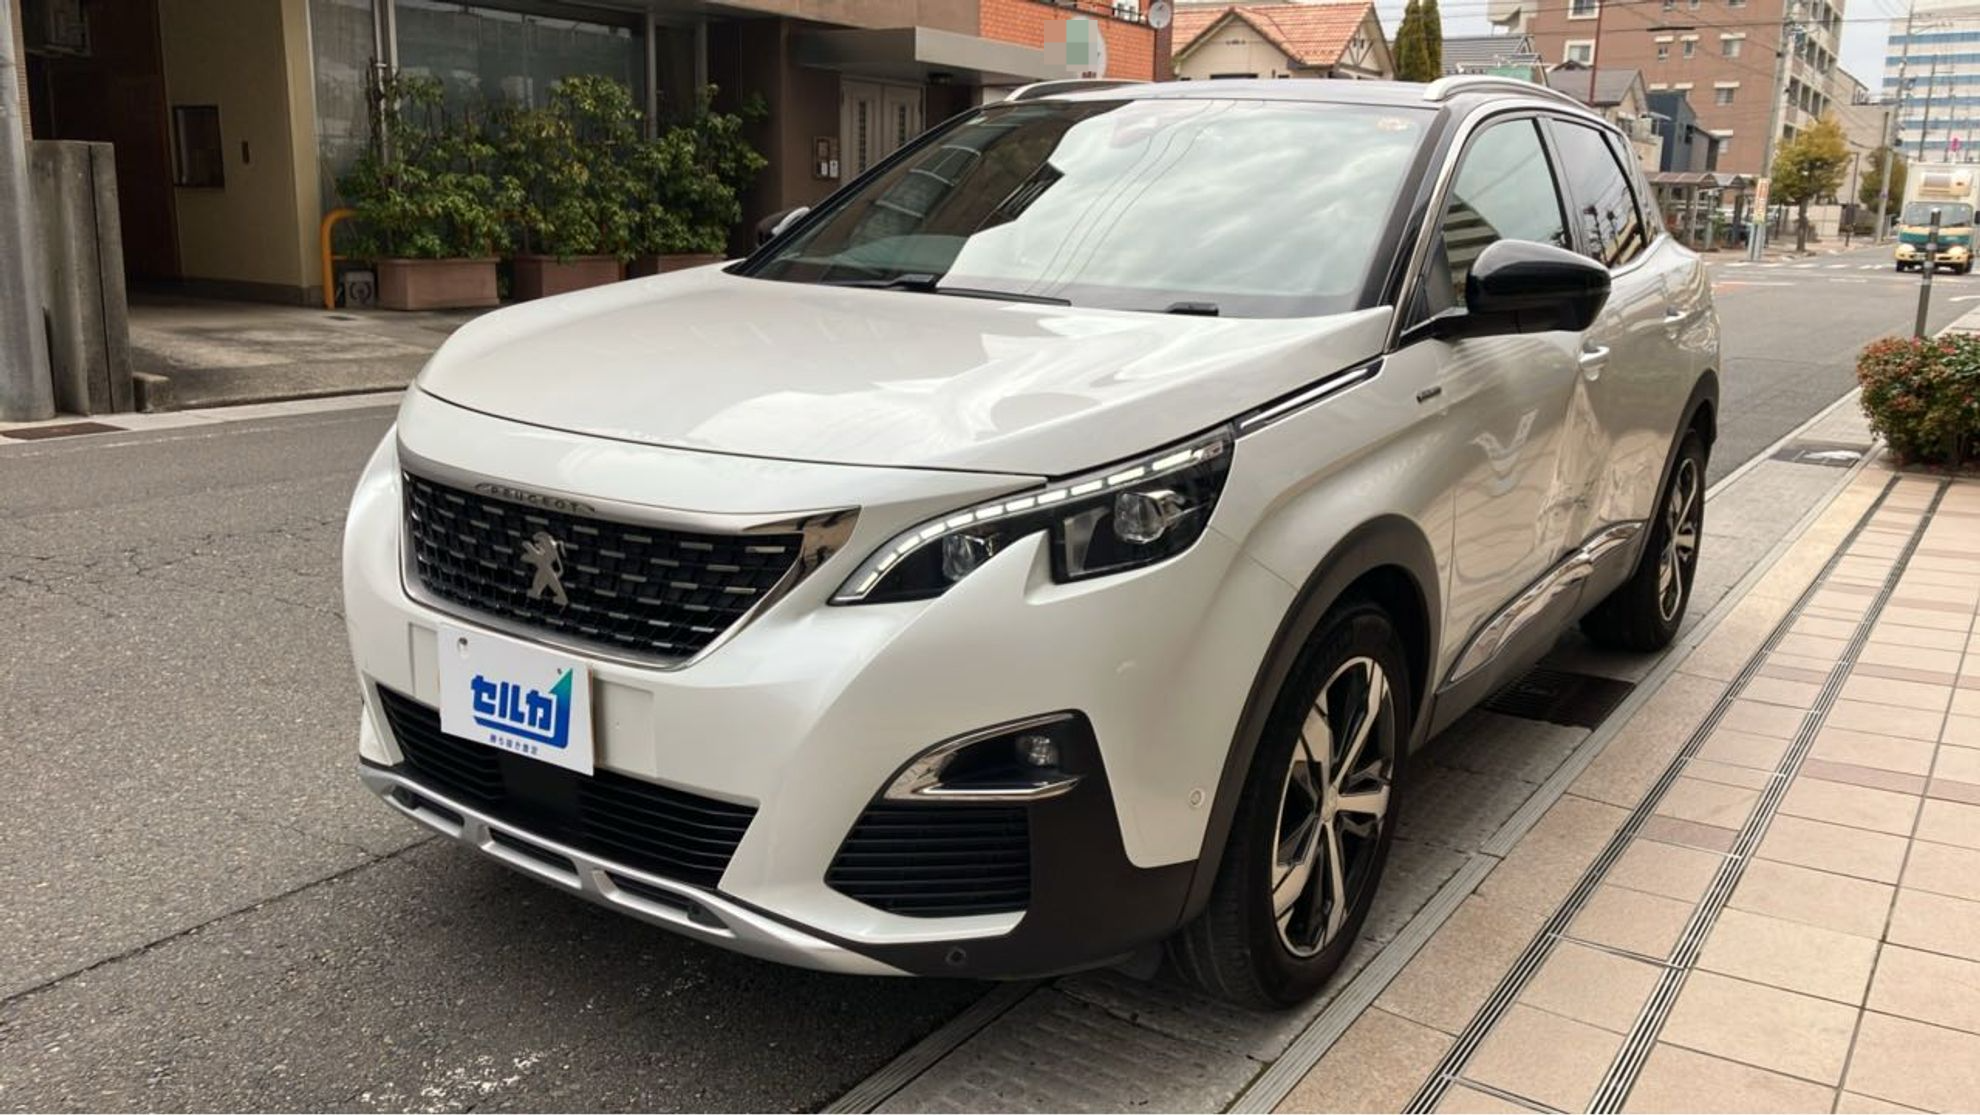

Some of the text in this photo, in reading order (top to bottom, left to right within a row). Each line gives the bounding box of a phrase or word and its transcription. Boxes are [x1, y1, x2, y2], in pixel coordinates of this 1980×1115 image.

[490, 485, 578, 513] PEUGEOT
[471, 674, 553, 731] セルカ
